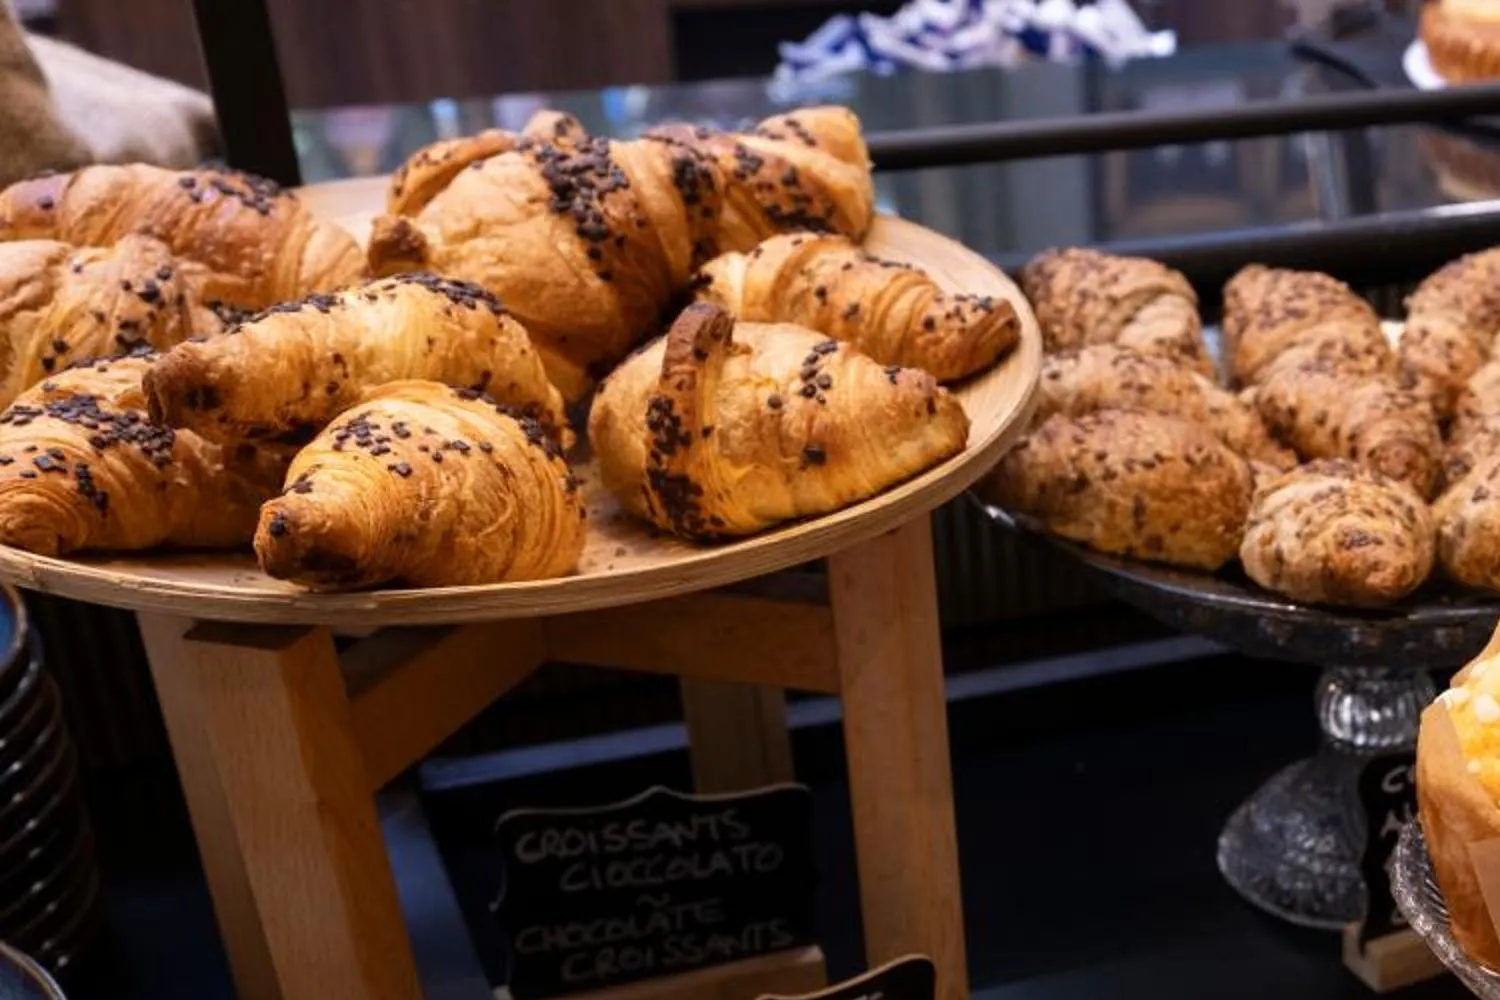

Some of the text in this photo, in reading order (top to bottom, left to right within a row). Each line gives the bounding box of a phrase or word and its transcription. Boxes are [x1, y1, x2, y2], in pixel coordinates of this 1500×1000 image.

[514, 808, 751, 864] CROISSANTS
[559, 842, 785, 892] CIOCCOLATO
[515, 897, 726, 953] CHOCOLATE
[561, 917, 794, 981] CROISSANTS
